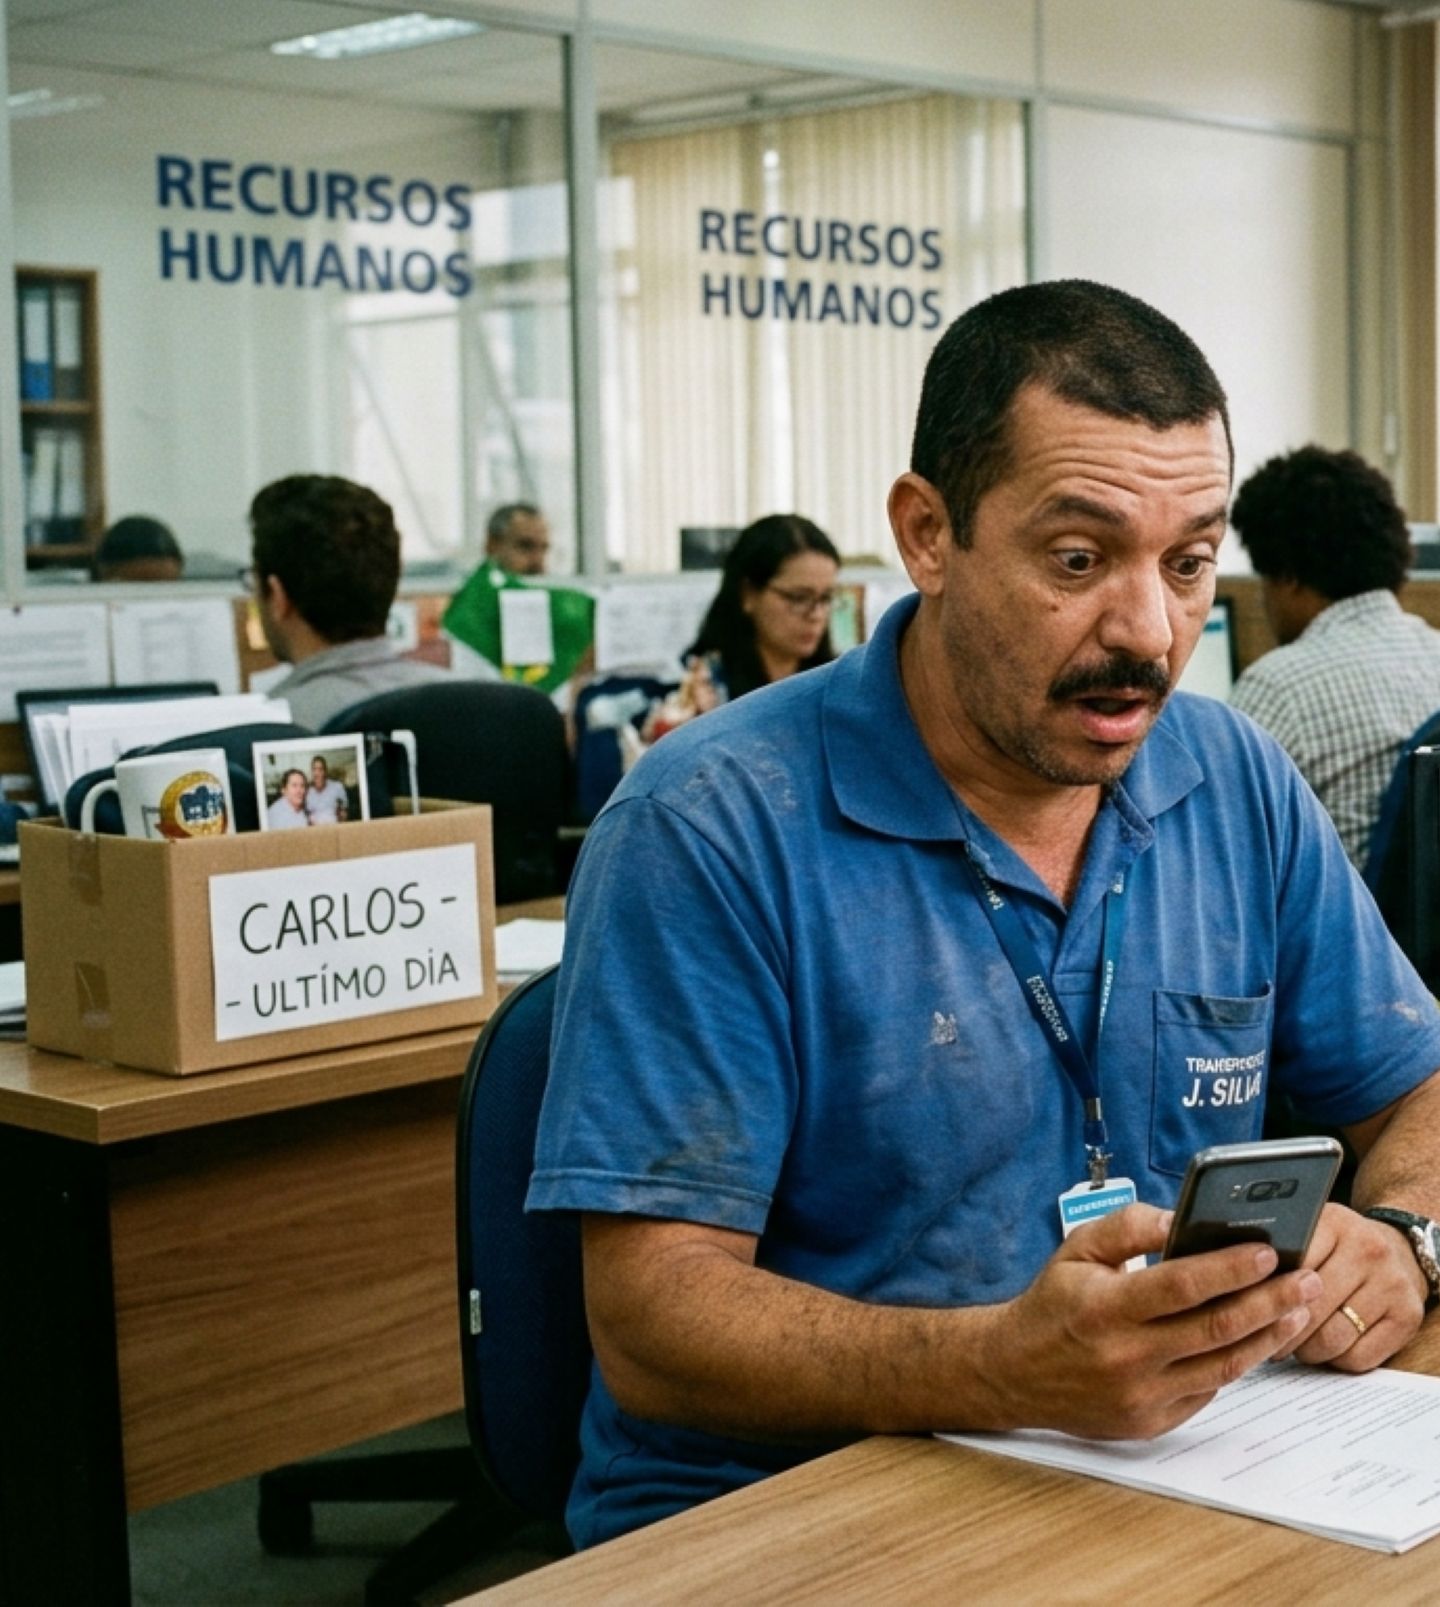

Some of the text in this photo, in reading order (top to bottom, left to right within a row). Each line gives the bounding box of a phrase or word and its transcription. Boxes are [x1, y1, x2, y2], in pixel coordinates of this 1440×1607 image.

[157, 155, 473, 231] RECURSOS
[160, 228, 473, 296] HUMANOS
[700, 209, 942, 271] RECURSOS
[702, 272, 941, 329] HUMANOS
[239, 882, 425, 954] CARLOS
[1182, 1078, 1204, 1107] J.
